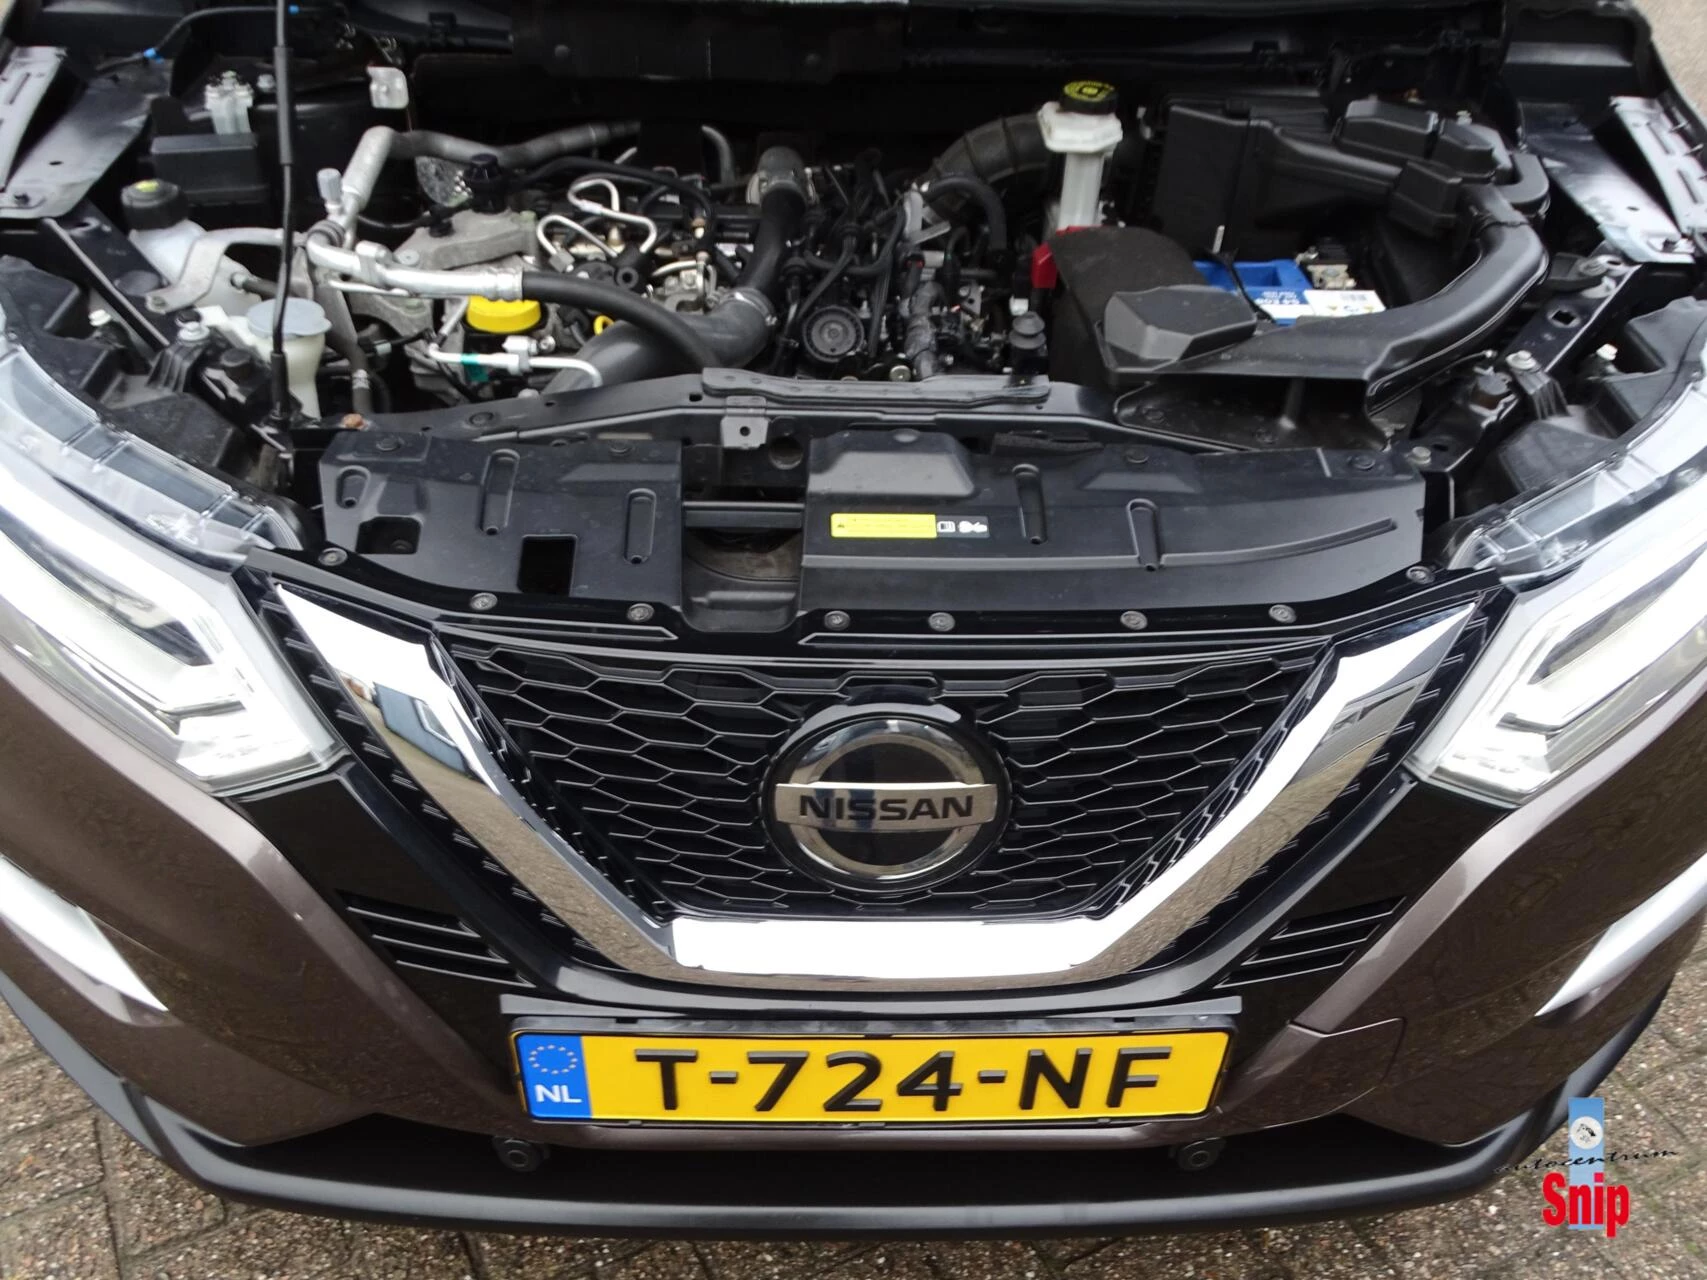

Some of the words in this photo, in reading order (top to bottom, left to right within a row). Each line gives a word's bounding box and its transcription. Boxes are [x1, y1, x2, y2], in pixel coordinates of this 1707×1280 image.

[800, 795, 973, 820] NISSAN
[635, 1047, 1173, 1111] T-724-NF
[534, 1084, 582, 1103] NL
